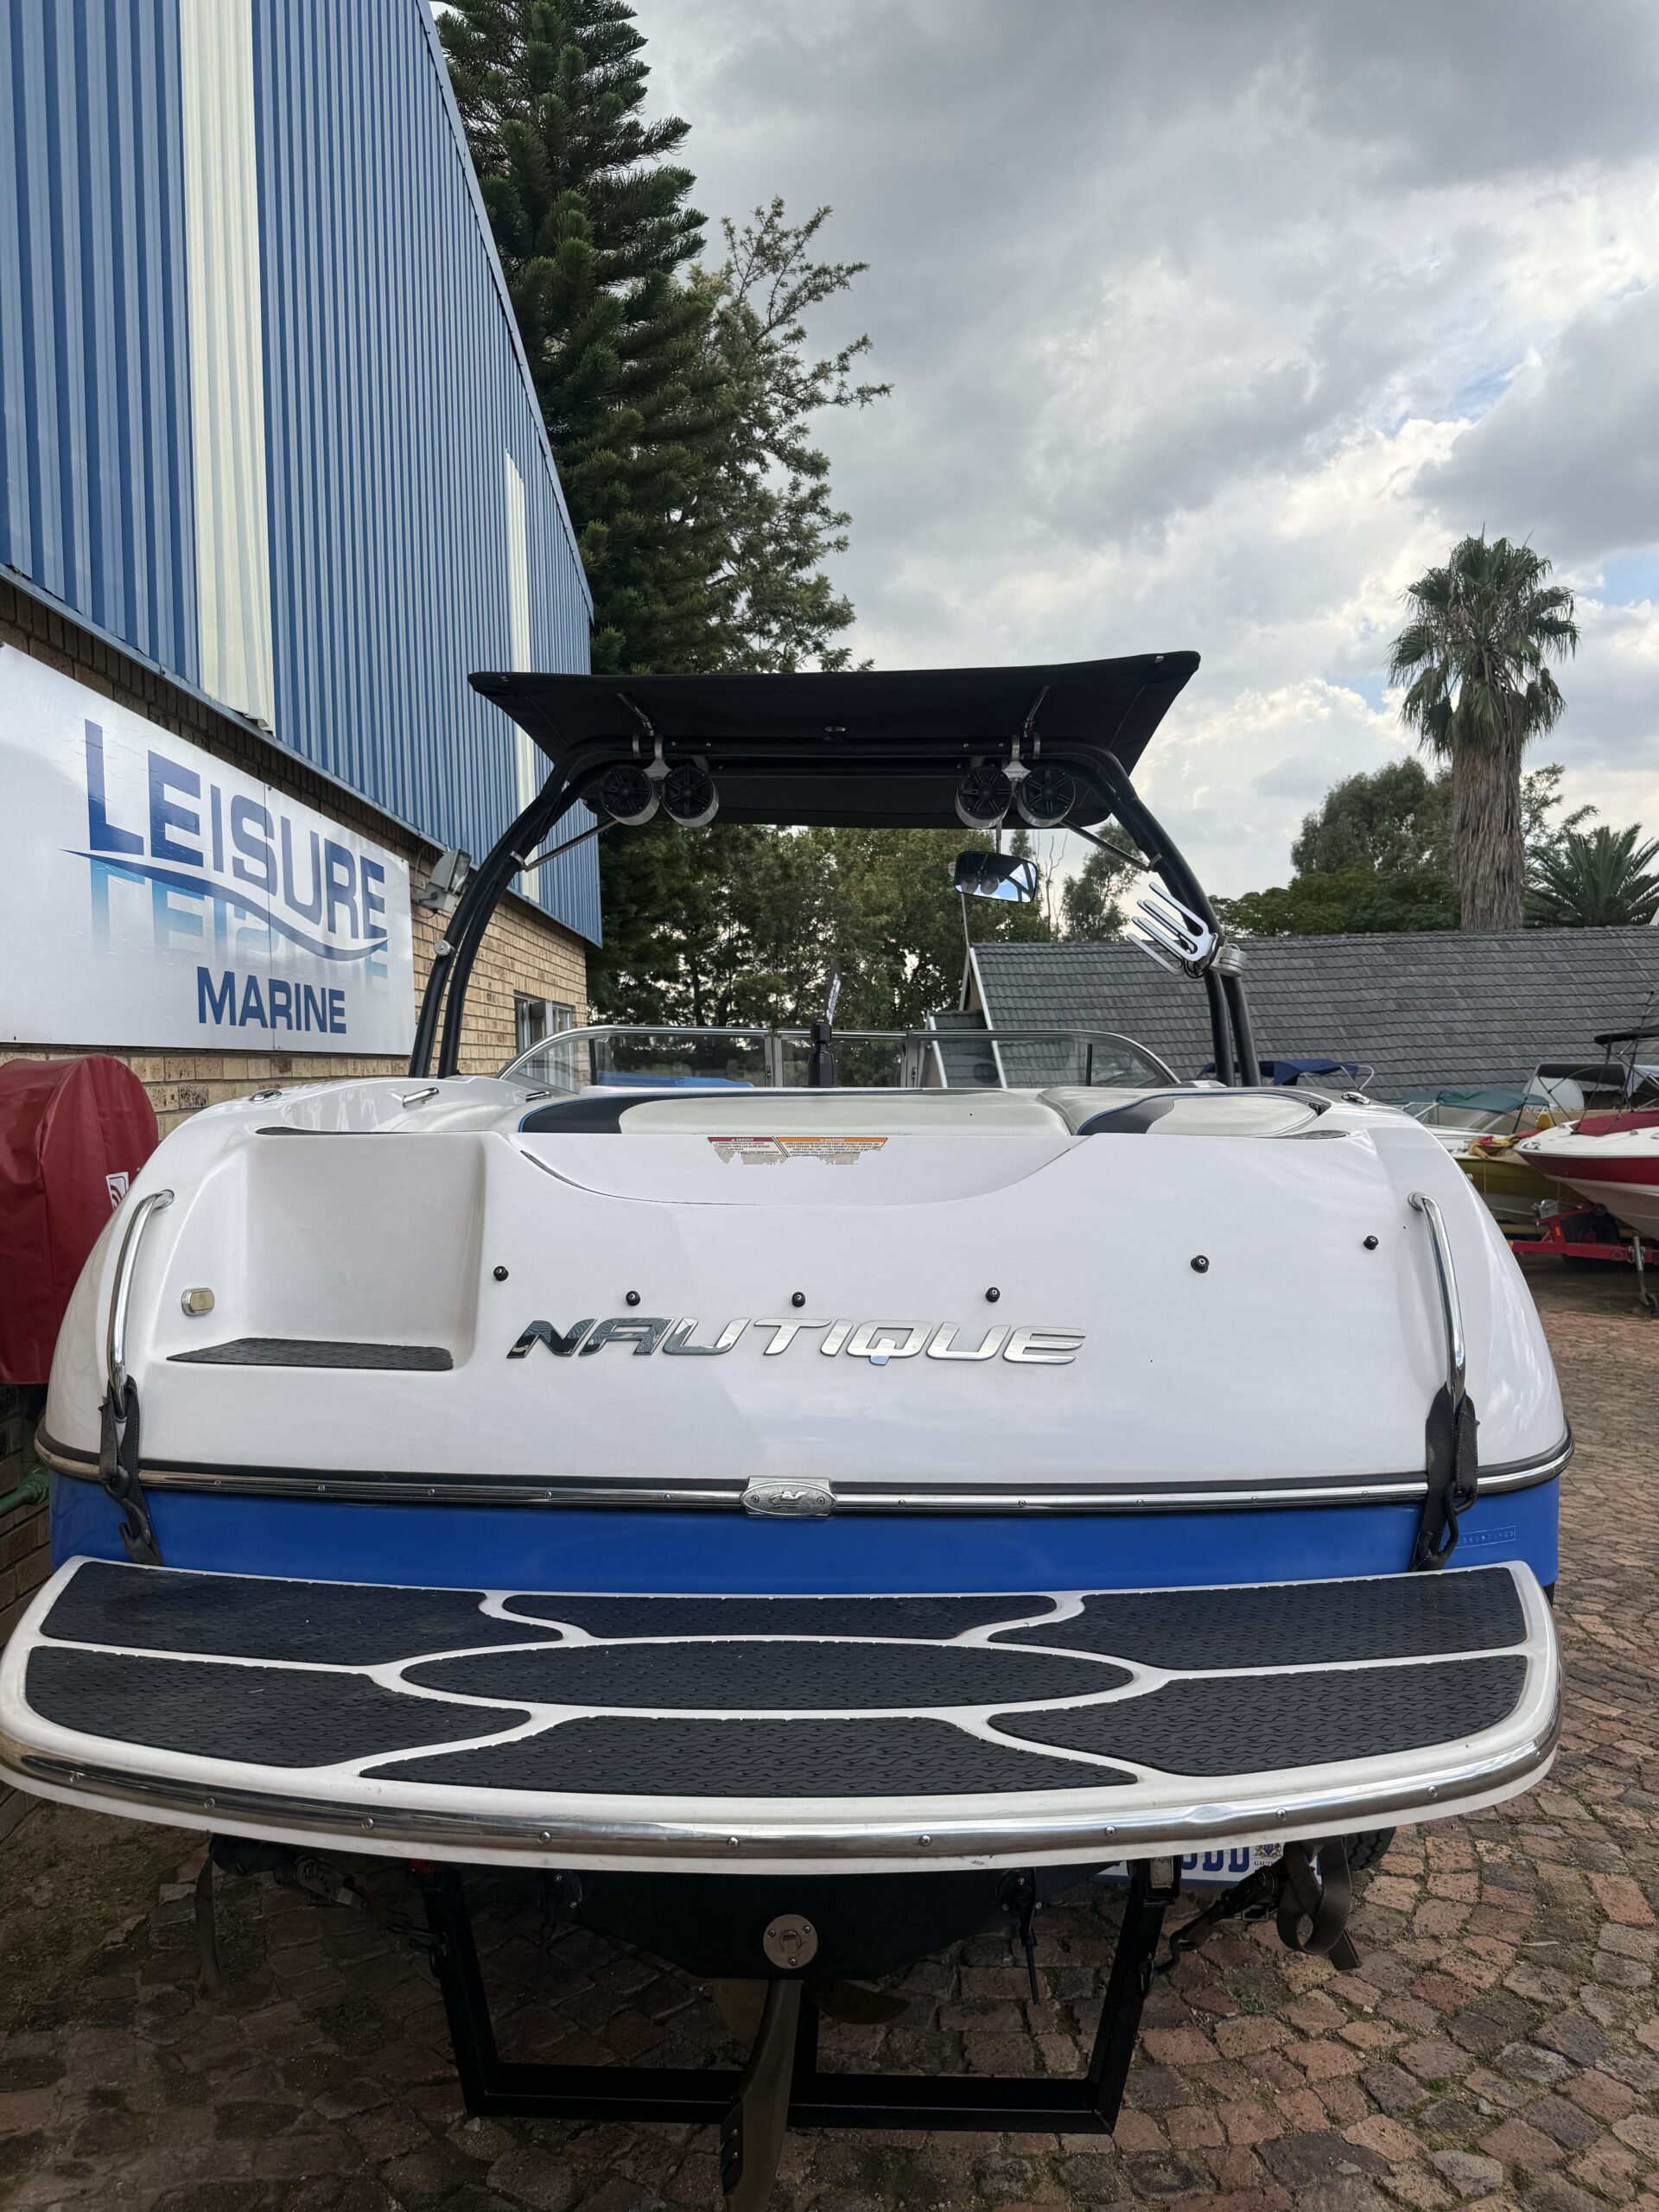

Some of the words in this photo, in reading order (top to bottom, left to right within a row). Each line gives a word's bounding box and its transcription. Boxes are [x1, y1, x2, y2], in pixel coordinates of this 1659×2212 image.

[85, 718, 388, 939] LEISURE
[196, 965, 346, 1034] MARINE
[506, 1317, 1086, 1366] NAUTIQUE
